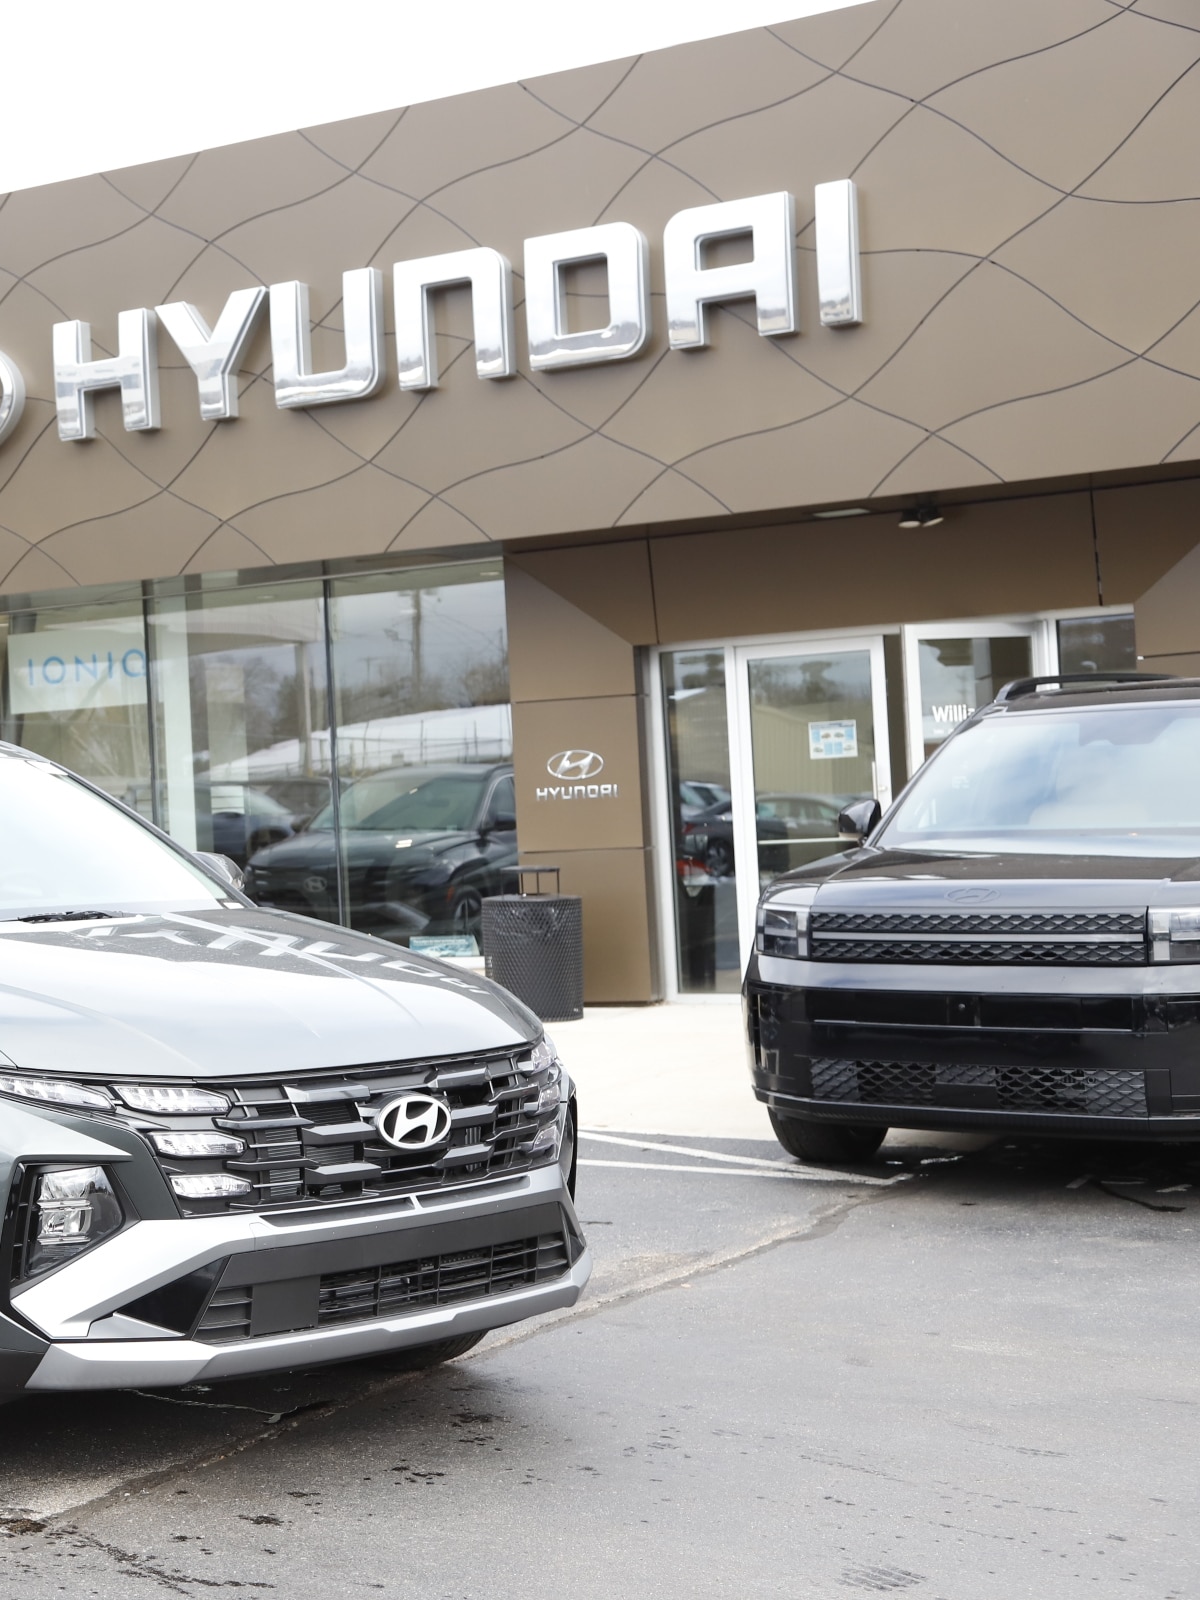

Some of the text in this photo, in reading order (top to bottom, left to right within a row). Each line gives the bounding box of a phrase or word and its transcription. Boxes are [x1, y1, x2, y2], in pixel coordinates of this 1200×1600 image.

[53, 178, 863, 441] HYUNDAI
[931, 704, 976, 722] Willi
[536, 784, 618, 801] HYUNDAI
